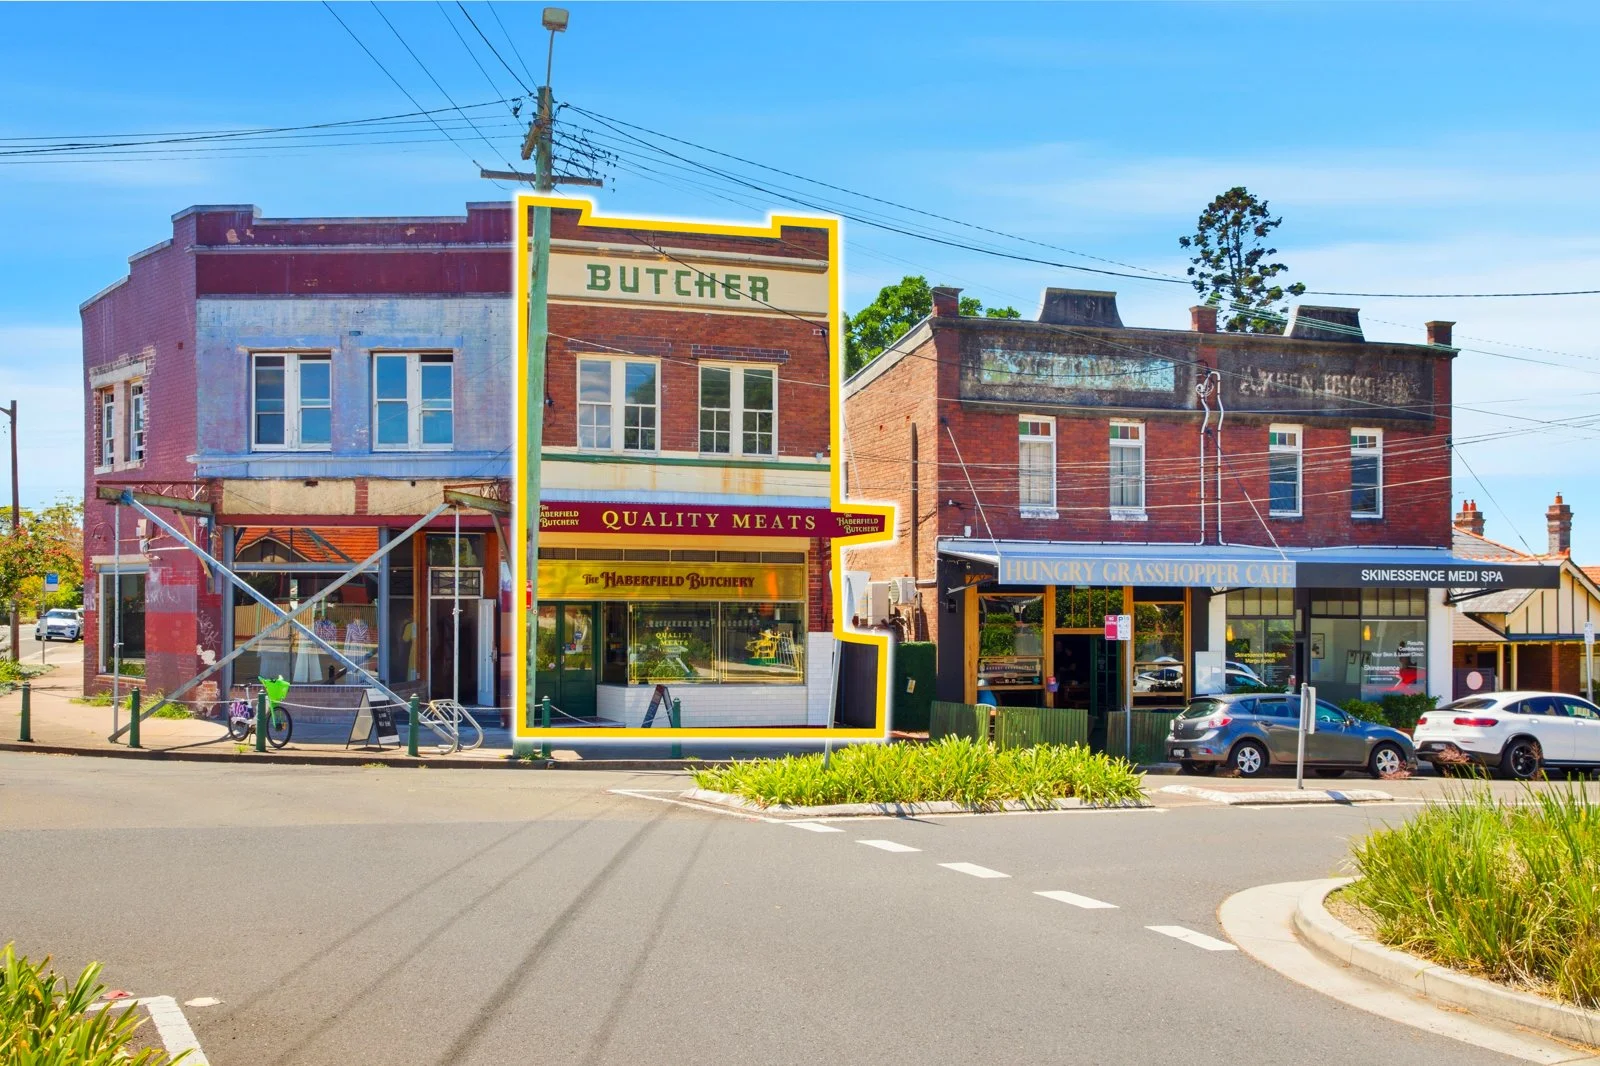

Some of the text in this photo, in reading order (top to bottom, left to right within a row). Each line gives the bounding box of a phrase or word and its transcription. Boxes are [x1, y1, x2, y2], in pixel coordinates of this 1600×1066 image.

[586, 263, 769, 302] BUTCHER
[540, 510, 579, 518] ABERFIELD
[602, 510, 816, 530] QUALITY MEATS
[540, 517, 579, 528] BUTCHERY
[836, 516, 879, 526] HABERFIELD
[843, 524, 879, 534] BUTCHERY
[1006, 559, 1293, 585] HUNGRY GRASSHOPPER CAFE
[1361, 569, 1504, 582] SKINESSENCE MEDI SPA
[600, 571, 685, 589] HABERFIELD
[686, 572, 756, 590] BUTCHERY
